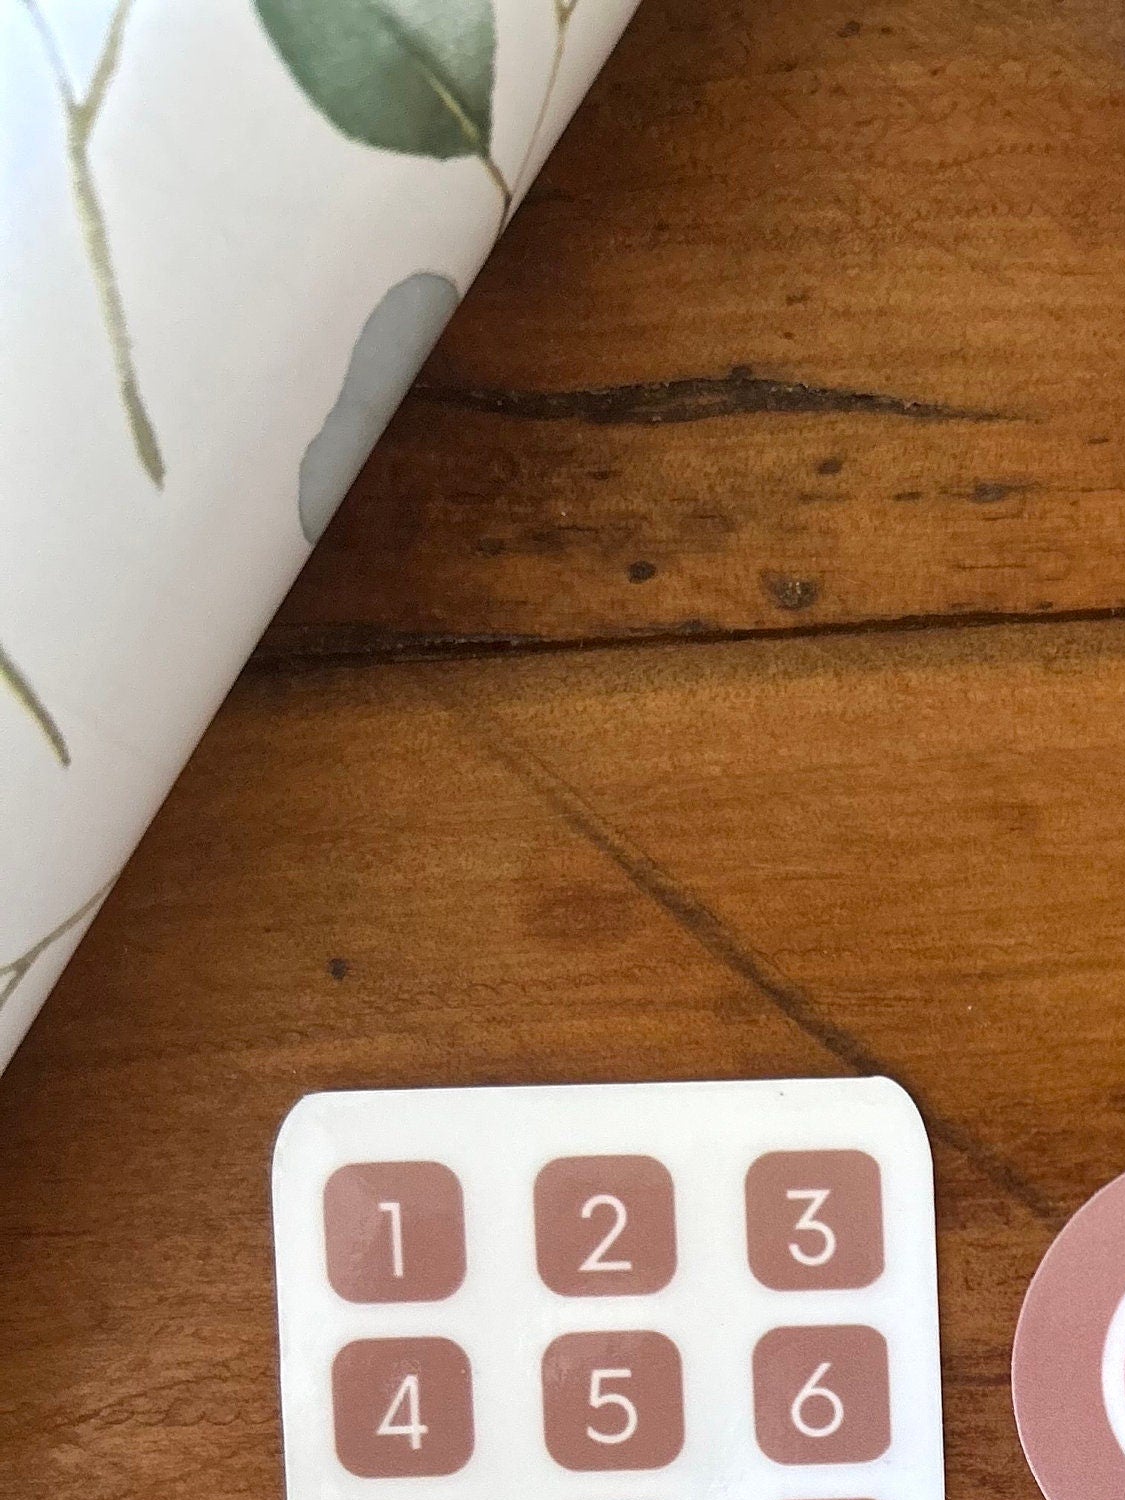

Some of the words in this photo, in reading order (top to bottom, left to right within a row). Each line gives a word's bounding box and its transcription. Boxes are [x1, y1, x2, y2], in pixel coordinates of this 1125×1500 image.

[377, 1200, 404, 1278] 1
[578, 1193, 633, 1273] 2
[786, 1188, 836, 1267] 3
[376, 1374, 429, 1451] 4
[586, 1367, 639, 1445] 5
[790, 1362, 845, 1439] 6
